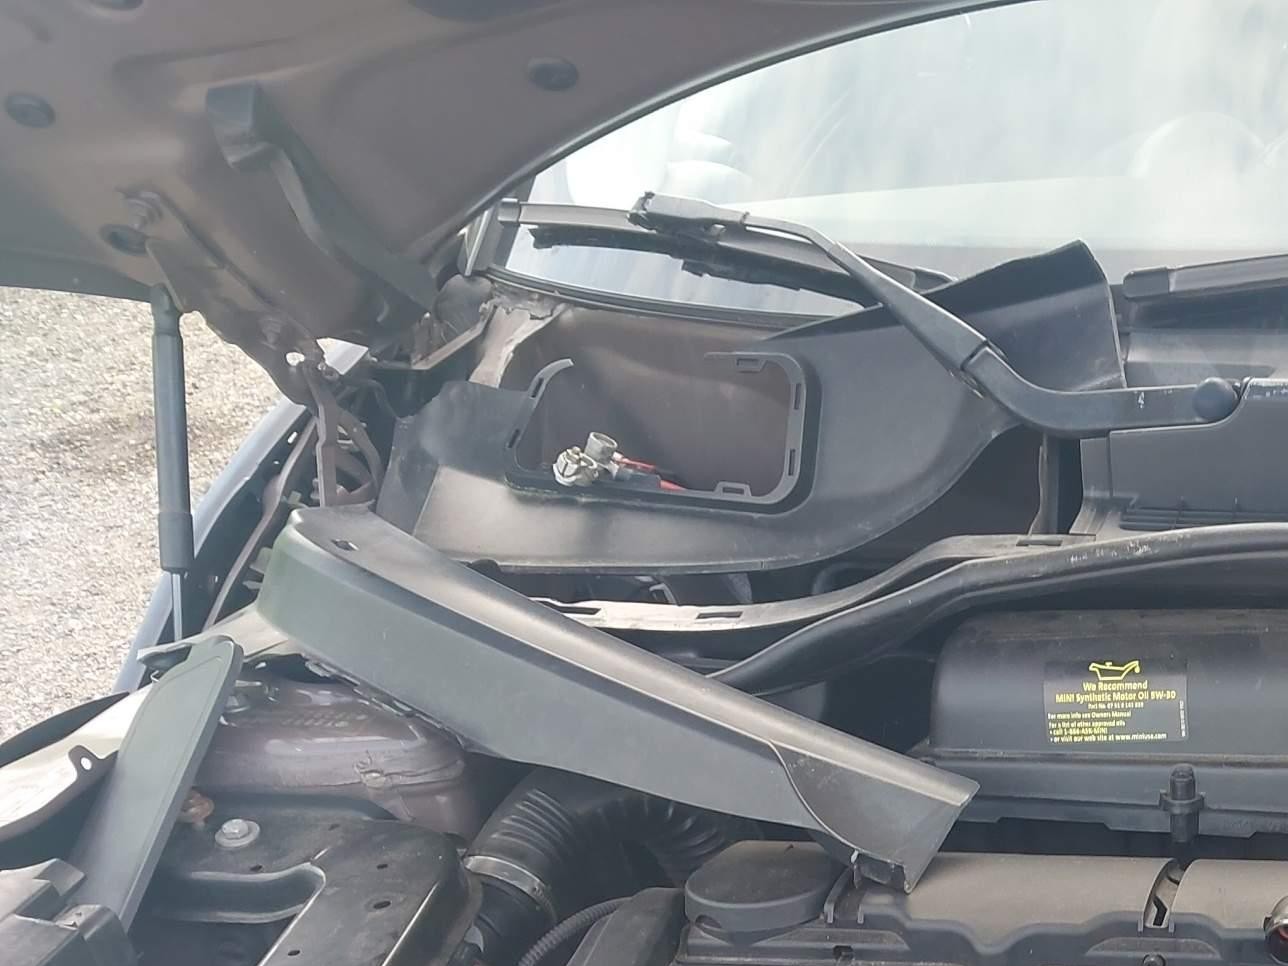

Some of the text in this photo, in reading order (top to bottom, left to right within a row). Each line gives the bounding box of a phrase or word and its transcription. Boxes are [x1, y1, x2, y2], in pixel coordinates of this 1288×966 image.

[1083, 680, 1147, 691] We Recommend
[1056, 694, 1075, 703] MINI
[1076, 692, 1111, 704] Synthetic
[1113, 692, 1136, 701] Motor
[1138, 691, 1149, 700] Oil
